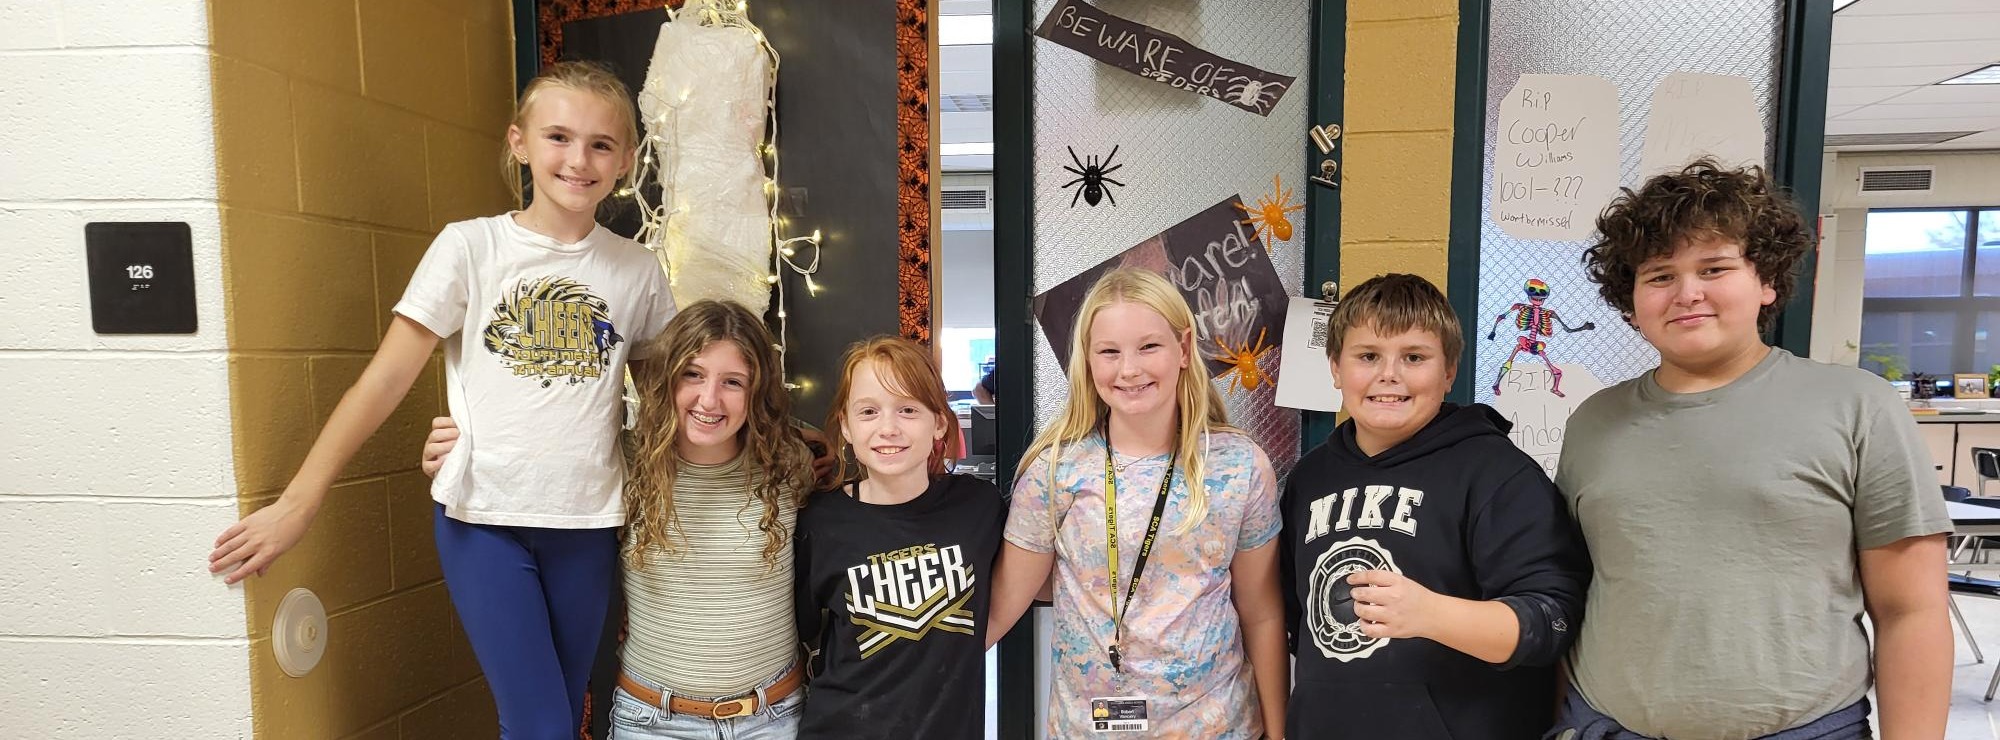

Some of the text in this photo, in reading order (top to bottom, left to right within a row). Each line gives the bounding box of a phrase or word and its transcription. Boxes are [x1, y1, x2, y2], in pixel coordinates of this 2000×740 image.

[1055, 5, 1236, 88] BEWARE OF
[1508, 116, 1587, 151] Cooper
[126, 265, 154, 279] 126
[517, 297, 596, 350] CHEER
[1508, 404, 1571, 448] Anda
[1141, 516, 1160, 557] SCA Tigers
[1304, 485, 1424, 544] NIKE
[867, 543, 938, 565] TIGERS
[847, 544, 968, 617] CHEER
